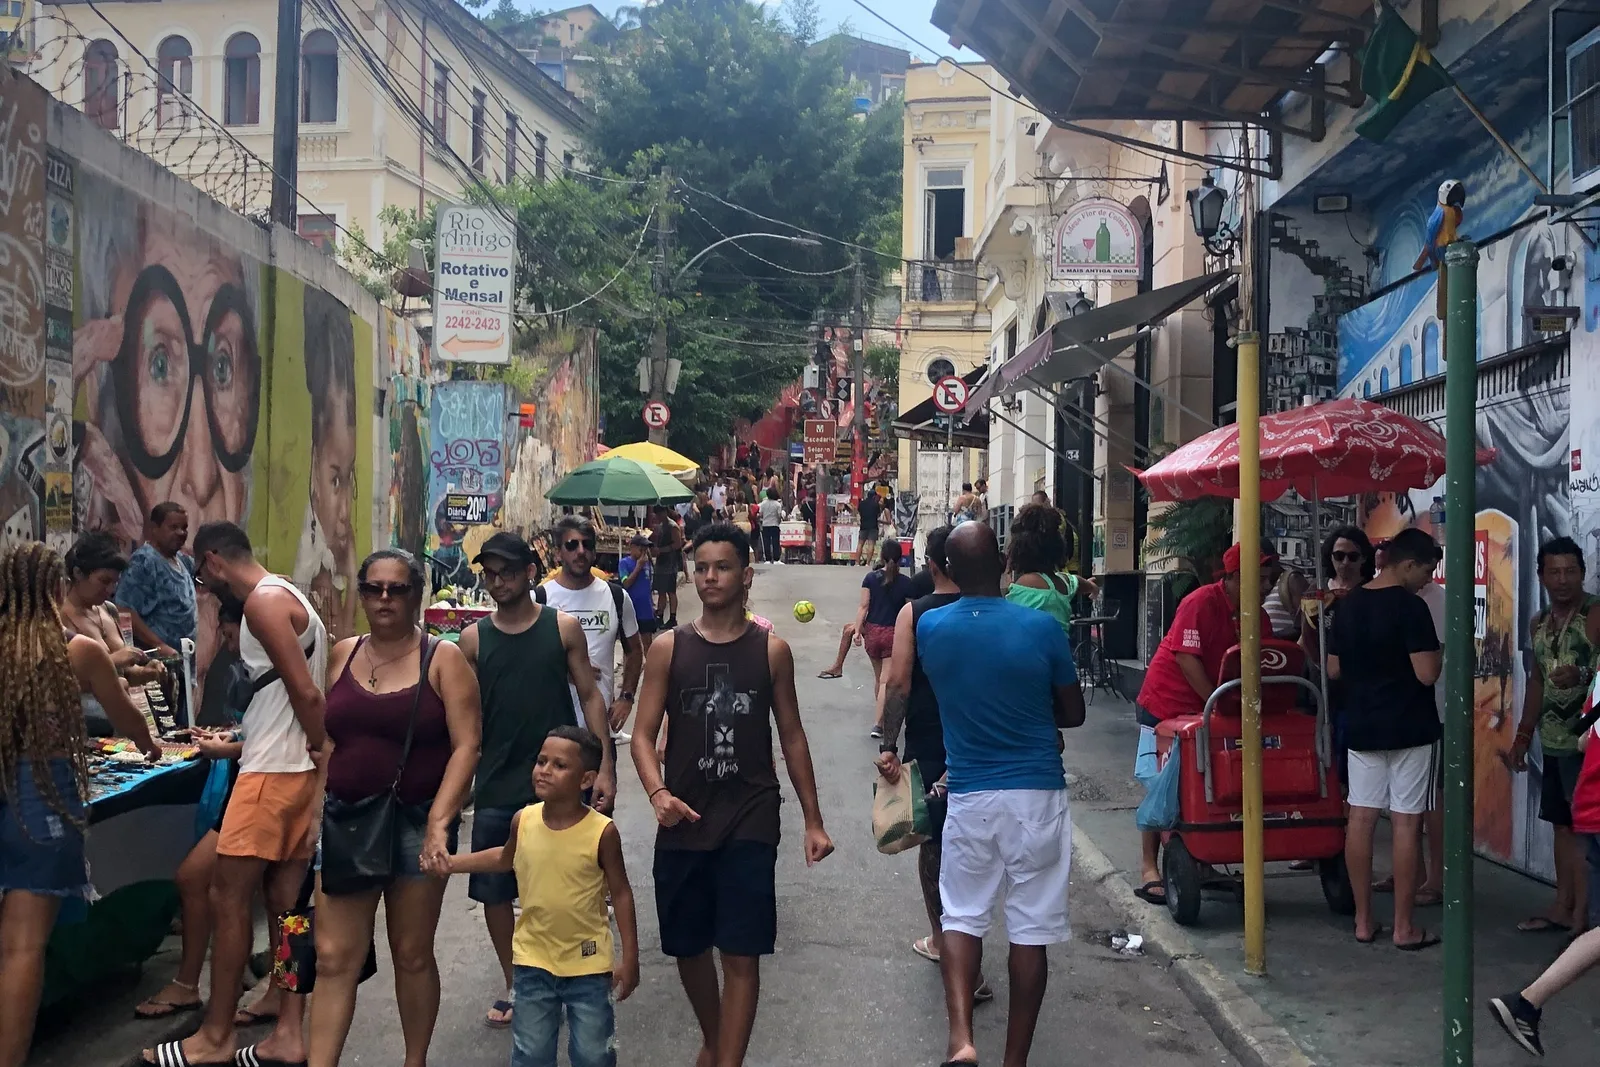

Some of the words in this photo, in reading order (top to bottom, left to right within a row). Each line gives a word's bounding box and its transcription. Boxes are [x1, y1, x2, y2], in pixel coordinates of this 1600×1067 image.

[449, 211, 485, 231] Rio
[441, 228, 511, 252] Antigo
[441, 261, 509, 278] Rotativo
[469, 279, 479, 289] e
[445, 288, 503, 303] Mensal
[445, 316, 501, 331] 2242-2423
